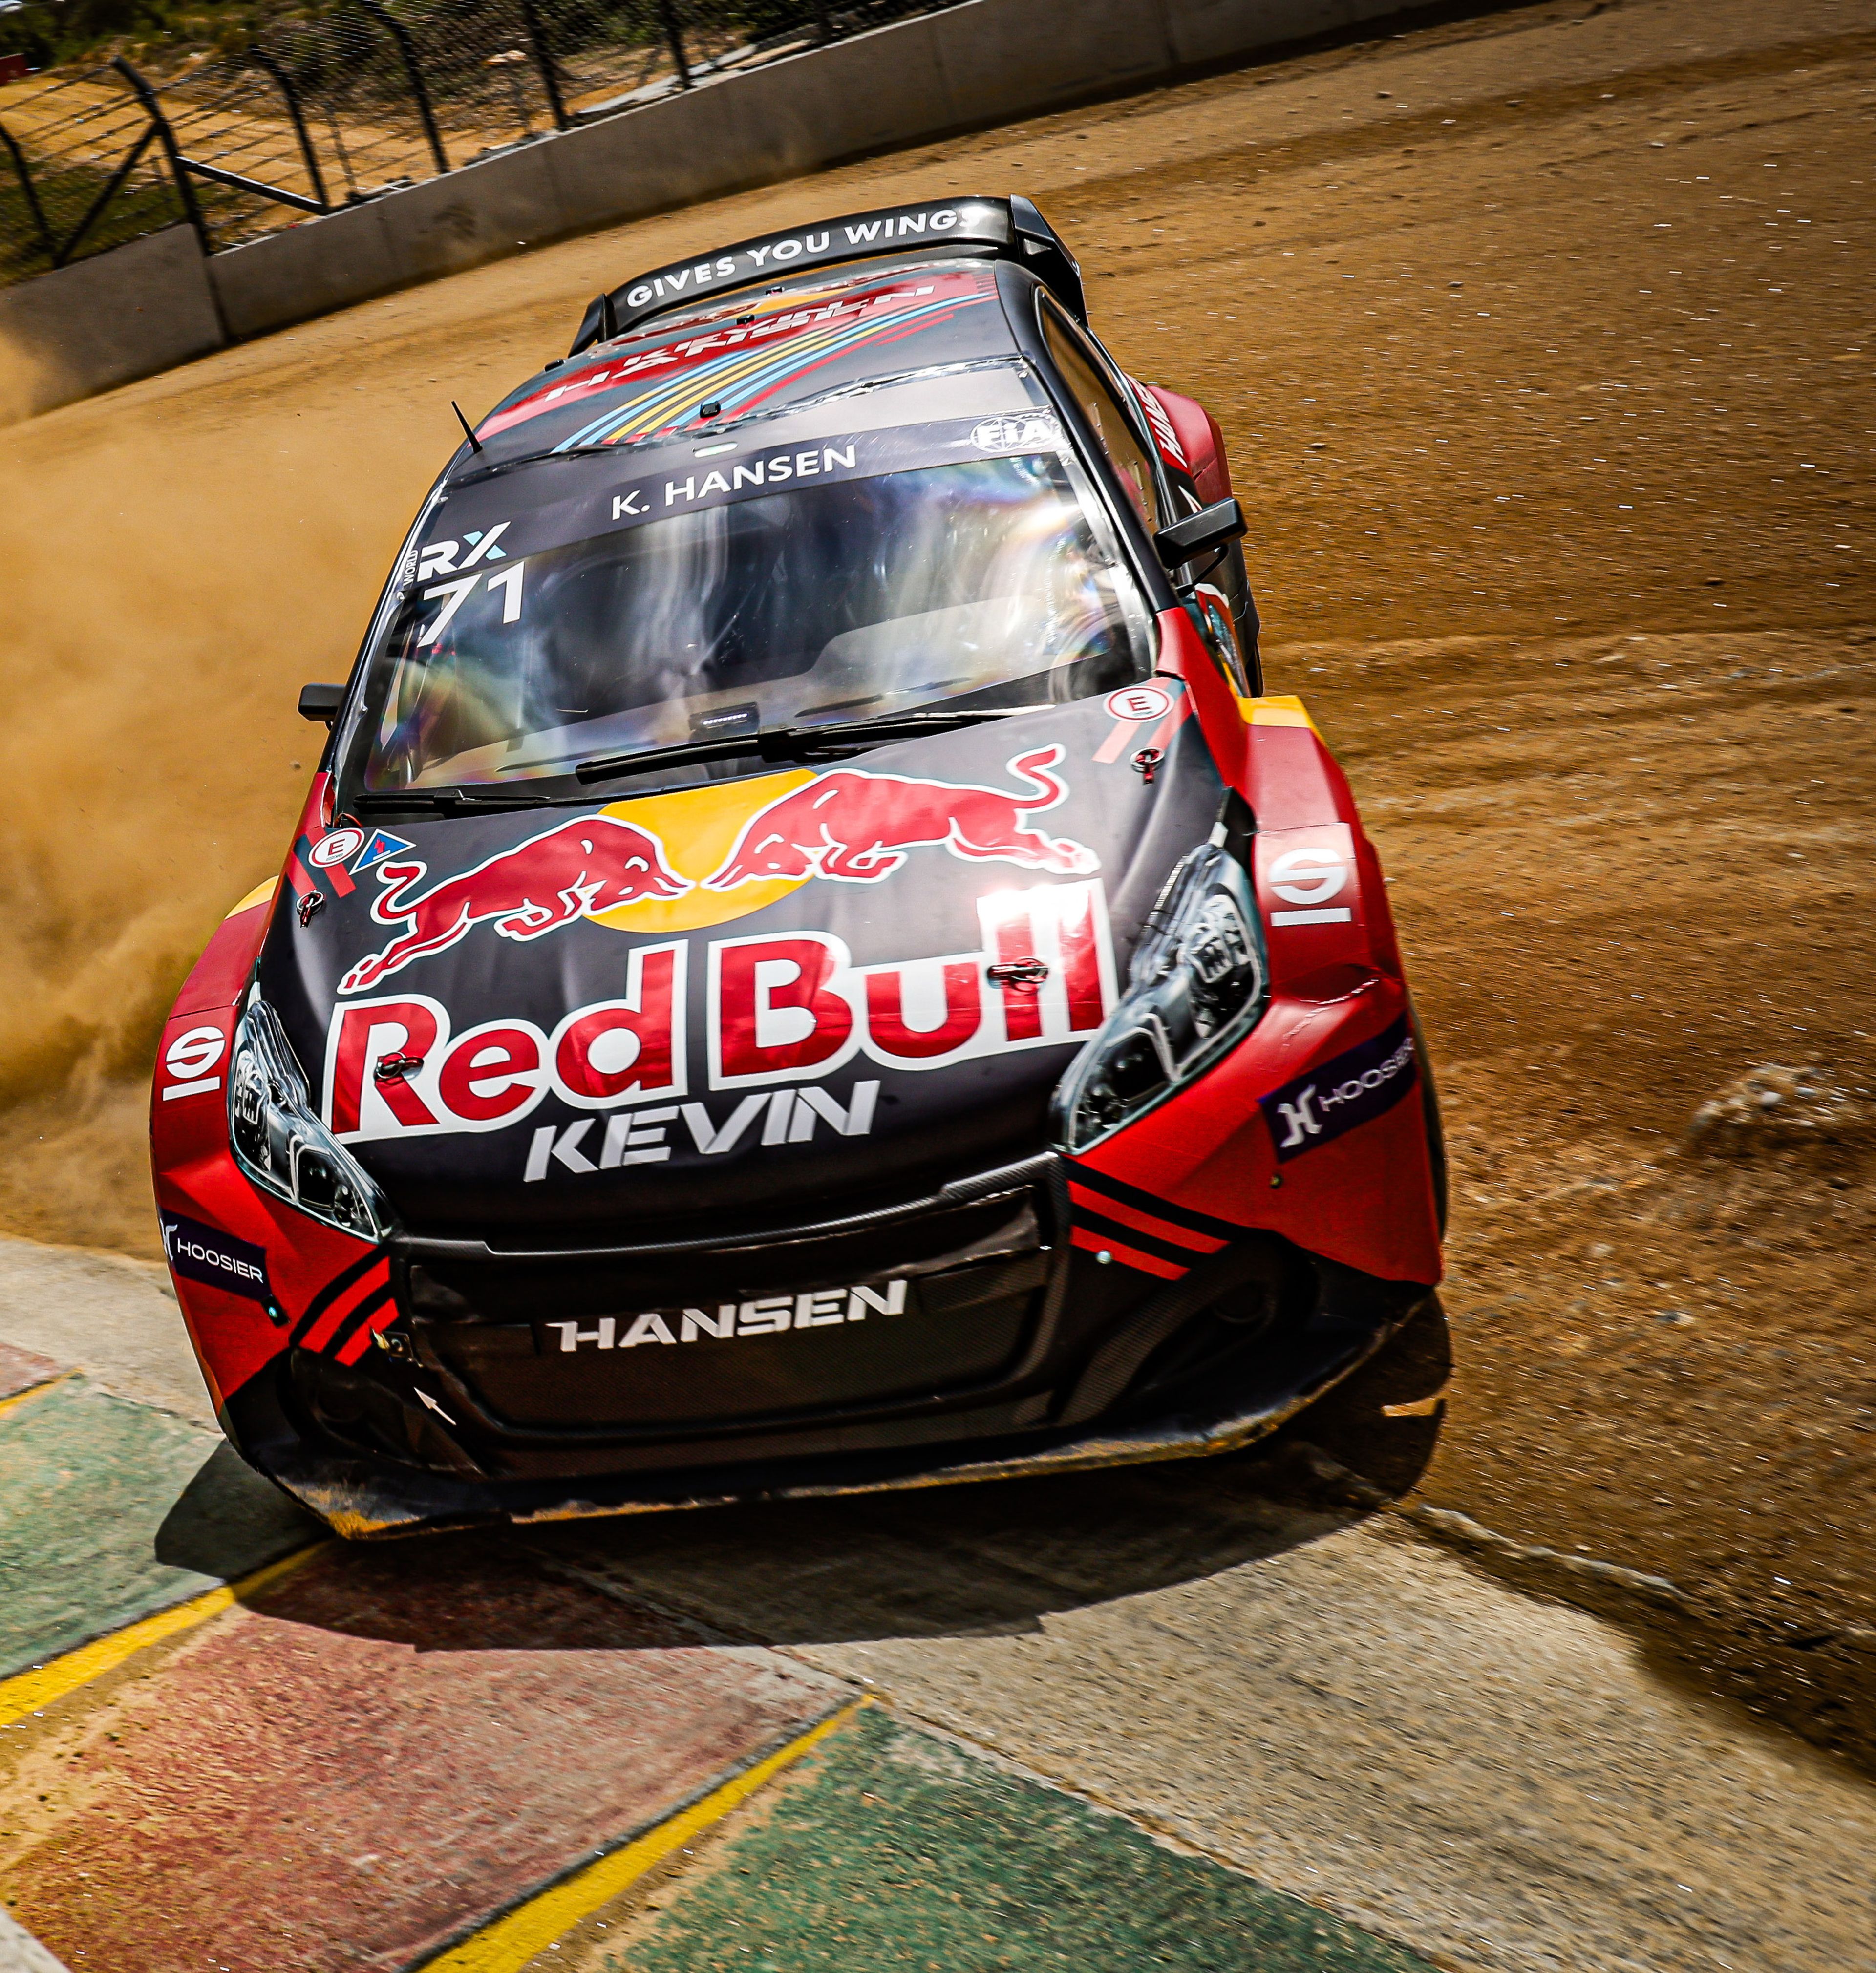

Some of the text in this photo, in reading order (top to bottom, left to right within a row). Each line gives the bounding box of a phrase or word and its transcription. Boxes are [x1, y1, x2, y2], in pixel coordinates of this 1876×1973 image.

[627, 256, 736, 307] GIVES
[746, 231, 830, 267] YOU
[612, 445, 856, 520] K. HANSEN
[403, 550, 419, 586] WORLD
[417, 521, 511, 582] RX
[417, 561, 525, 648] 71
[1126, 696, 1151, 711] E
[328, 838, 345, 856] E
[323, 879, 1119, 1143] Red Bull
[523, 1080, 880, 1183] KEVIN
[177, 1237, 264, 1284] HOOSIER
[545, 1279, 908, 1352] HANSEN
